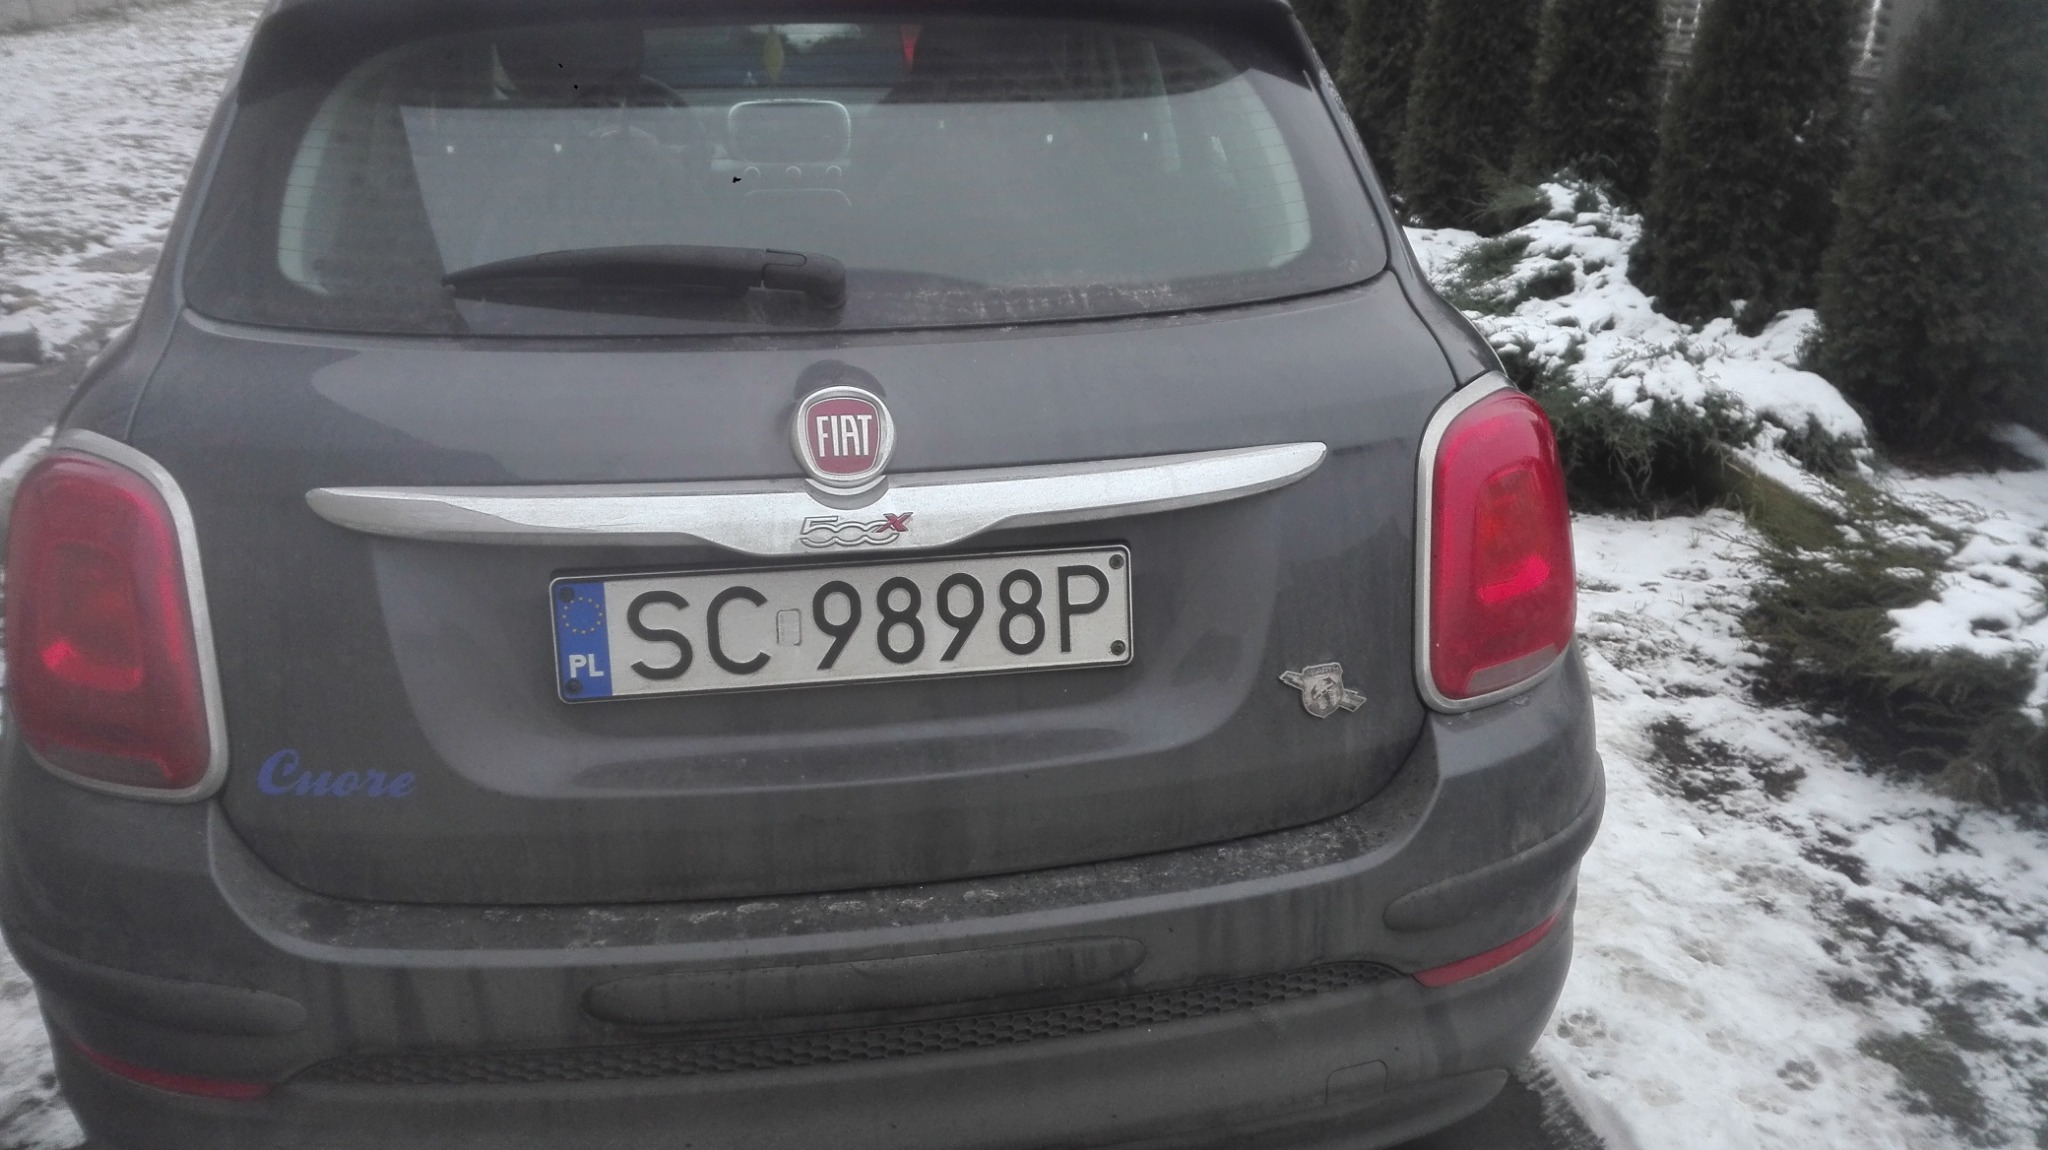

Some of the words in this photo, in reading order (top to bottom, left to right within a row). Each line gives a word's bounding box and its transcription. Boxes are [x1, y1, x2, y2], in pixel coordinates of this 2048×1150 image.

[816, 414, 872, 457] FIAT
[627, 586, 770, 680] SC
[812, 564, 1110, 670] 9898P
[568, 653, 604, 678] PL
[257, 748, 417, 798] Cuore
